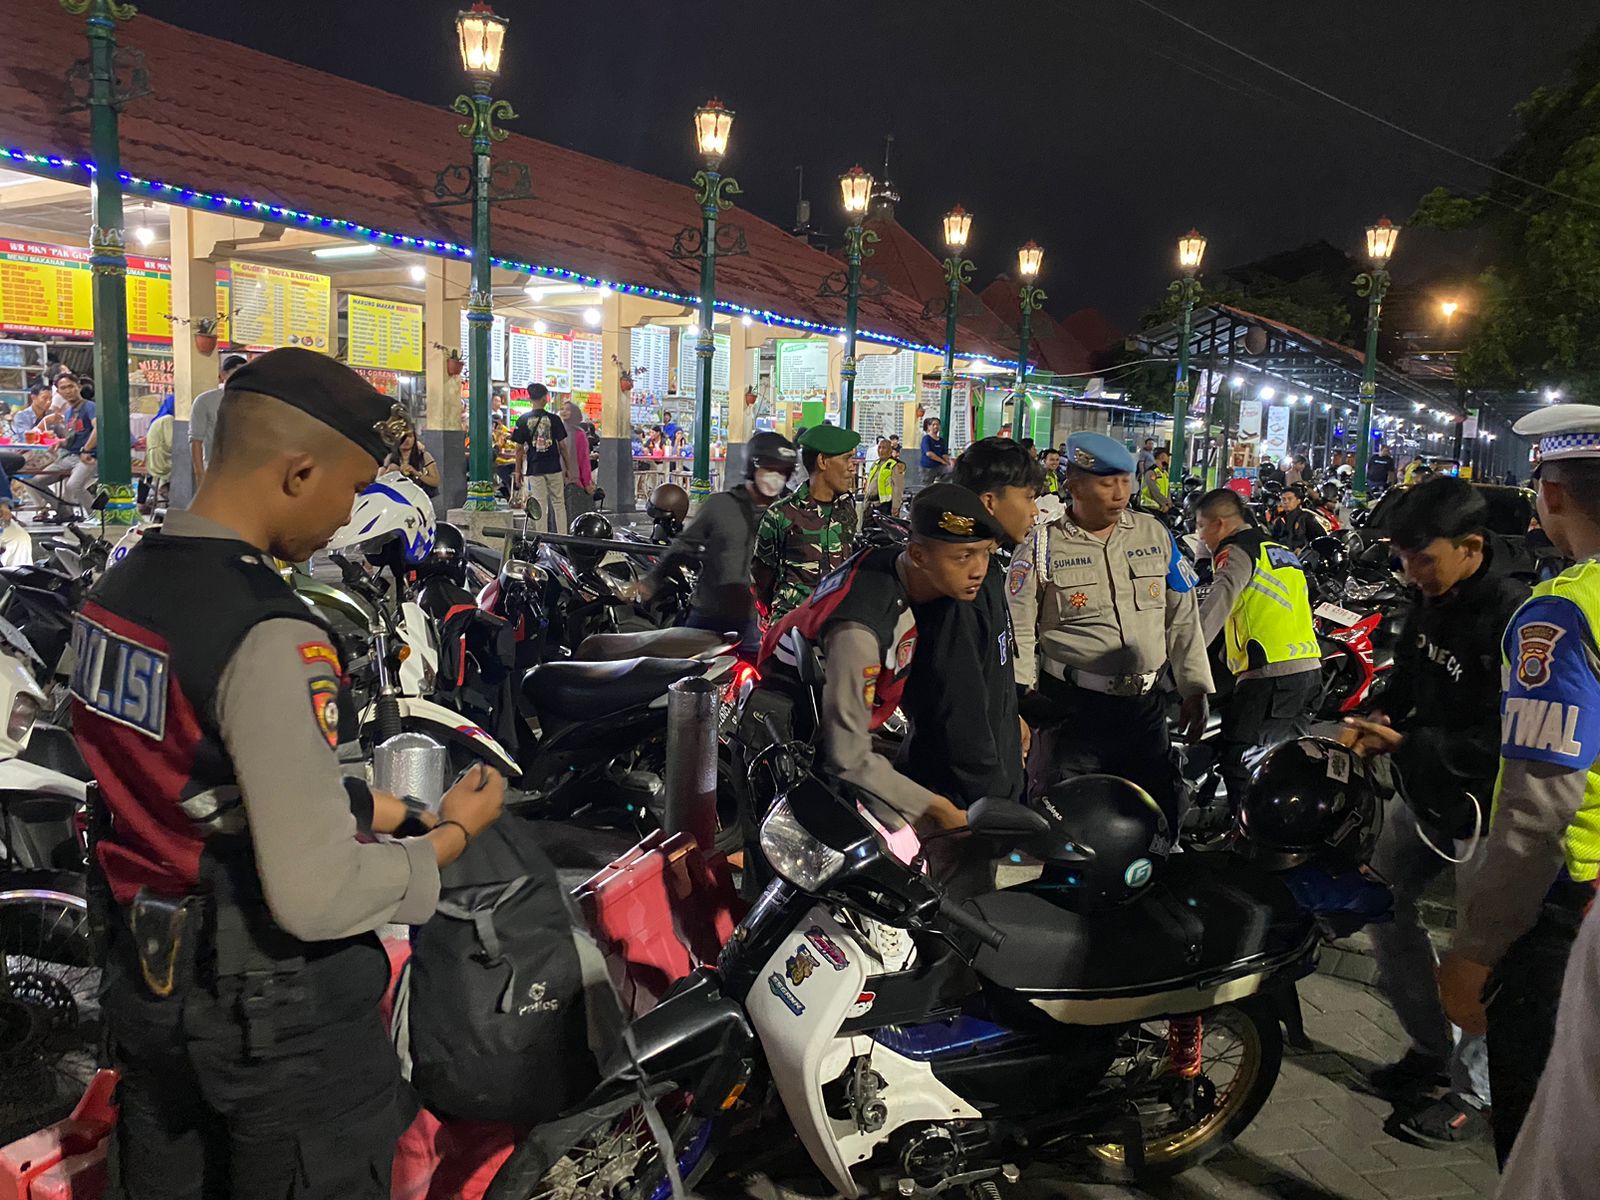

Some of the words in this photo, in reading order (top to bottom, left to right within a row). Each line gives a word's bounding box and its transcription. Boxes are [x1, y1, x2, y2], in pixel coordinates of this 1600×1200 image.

[7, 254, 28, 262] MENU
[30, 257, 65, 266] MAKANAN
[1127, 546, 1162, 559] POLRI
[1054, 556, 1092, 569] SUHARNA
[72, 621, 162, 729] POLISI
